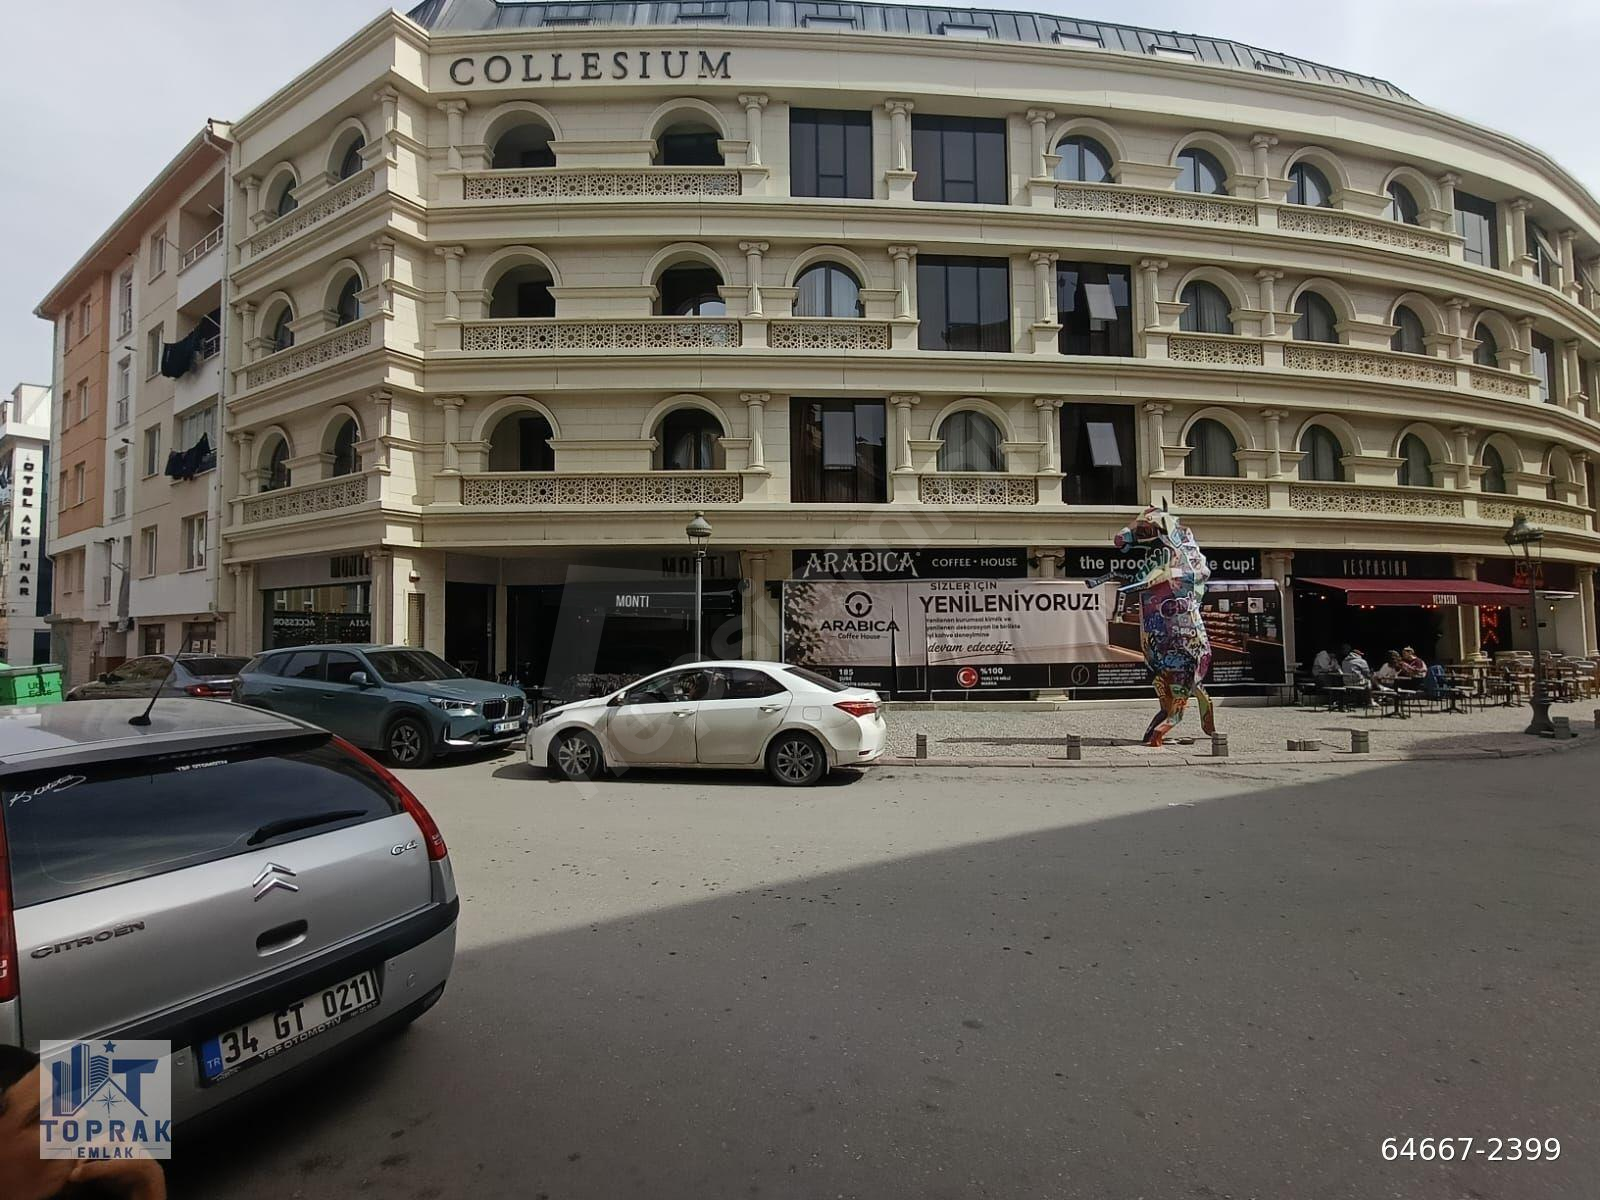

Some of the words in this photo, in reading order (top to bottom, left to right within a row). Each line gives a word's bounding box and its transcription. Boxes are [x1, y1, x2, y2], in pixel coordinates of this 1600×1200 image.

[450, 51, 731, 85] COLLESIUM
[22, 462, 34, 507] OTEL
[19, 514, 31, 596] AKPINAR
[802, 552, 920, 578] ARABICA
[932, 558, 972, 568] COFFEE
[980, 557, 1018, 567] HOUSE
[1080, 555, 1104, 570] the
[1223, 556, 1255, 573] cup!
[616, 594, 649, 608] MONTI
[919, 590, 1099, 613] YENİLENİYORUZ!
[820, 620, 900, 632] ARABICA
[928, 641, 963, 653] devam
[967, 641, 1015, 656] edeceğiz.
[980, 667, 1003, 675] %100
[391, 840, 418, 856] C4
[30, 920, 145, 960] CITROËN
[207, 1057, 221, 1070] TR
[222, 1026, 259, 1063] 34
[272, 1002, 305, 1040] GT
[322, 974, 371, 1018] 0211
